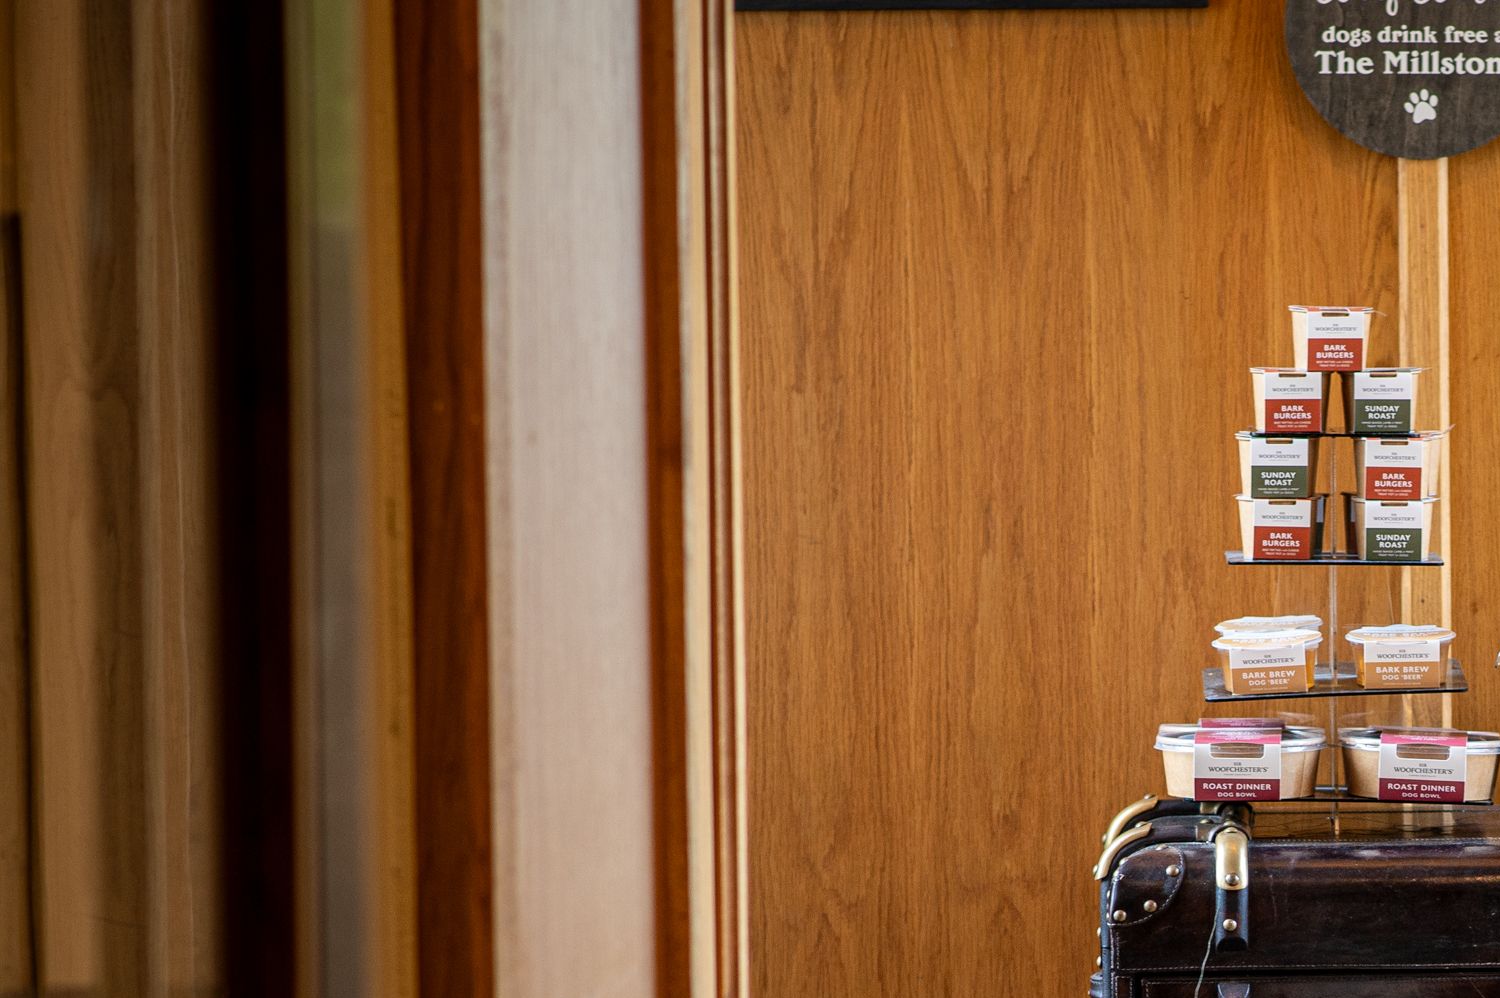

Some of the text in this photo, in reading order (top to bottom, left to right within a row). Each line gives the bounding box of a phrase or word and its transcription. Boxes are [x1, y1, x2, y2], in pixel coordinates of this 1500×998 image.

[1321, 25, 1372, 47] dogs
[1377, 24, 1438, 44] drink
[1443, 25, 1489, 44] free
[1314, 50, 1375, 75] The
[1315, 351, 1354, 359] BURGERS
[1260, 471, 1296, 479] SUNDAY
[1374, 480, 1413, 488] BURGERS
[1242, 670, 1296, 680] BARK BREW
[1236, 783, 1272, 791] DINNER
[1387, 783, 1456, 793] ROAST DINNER
